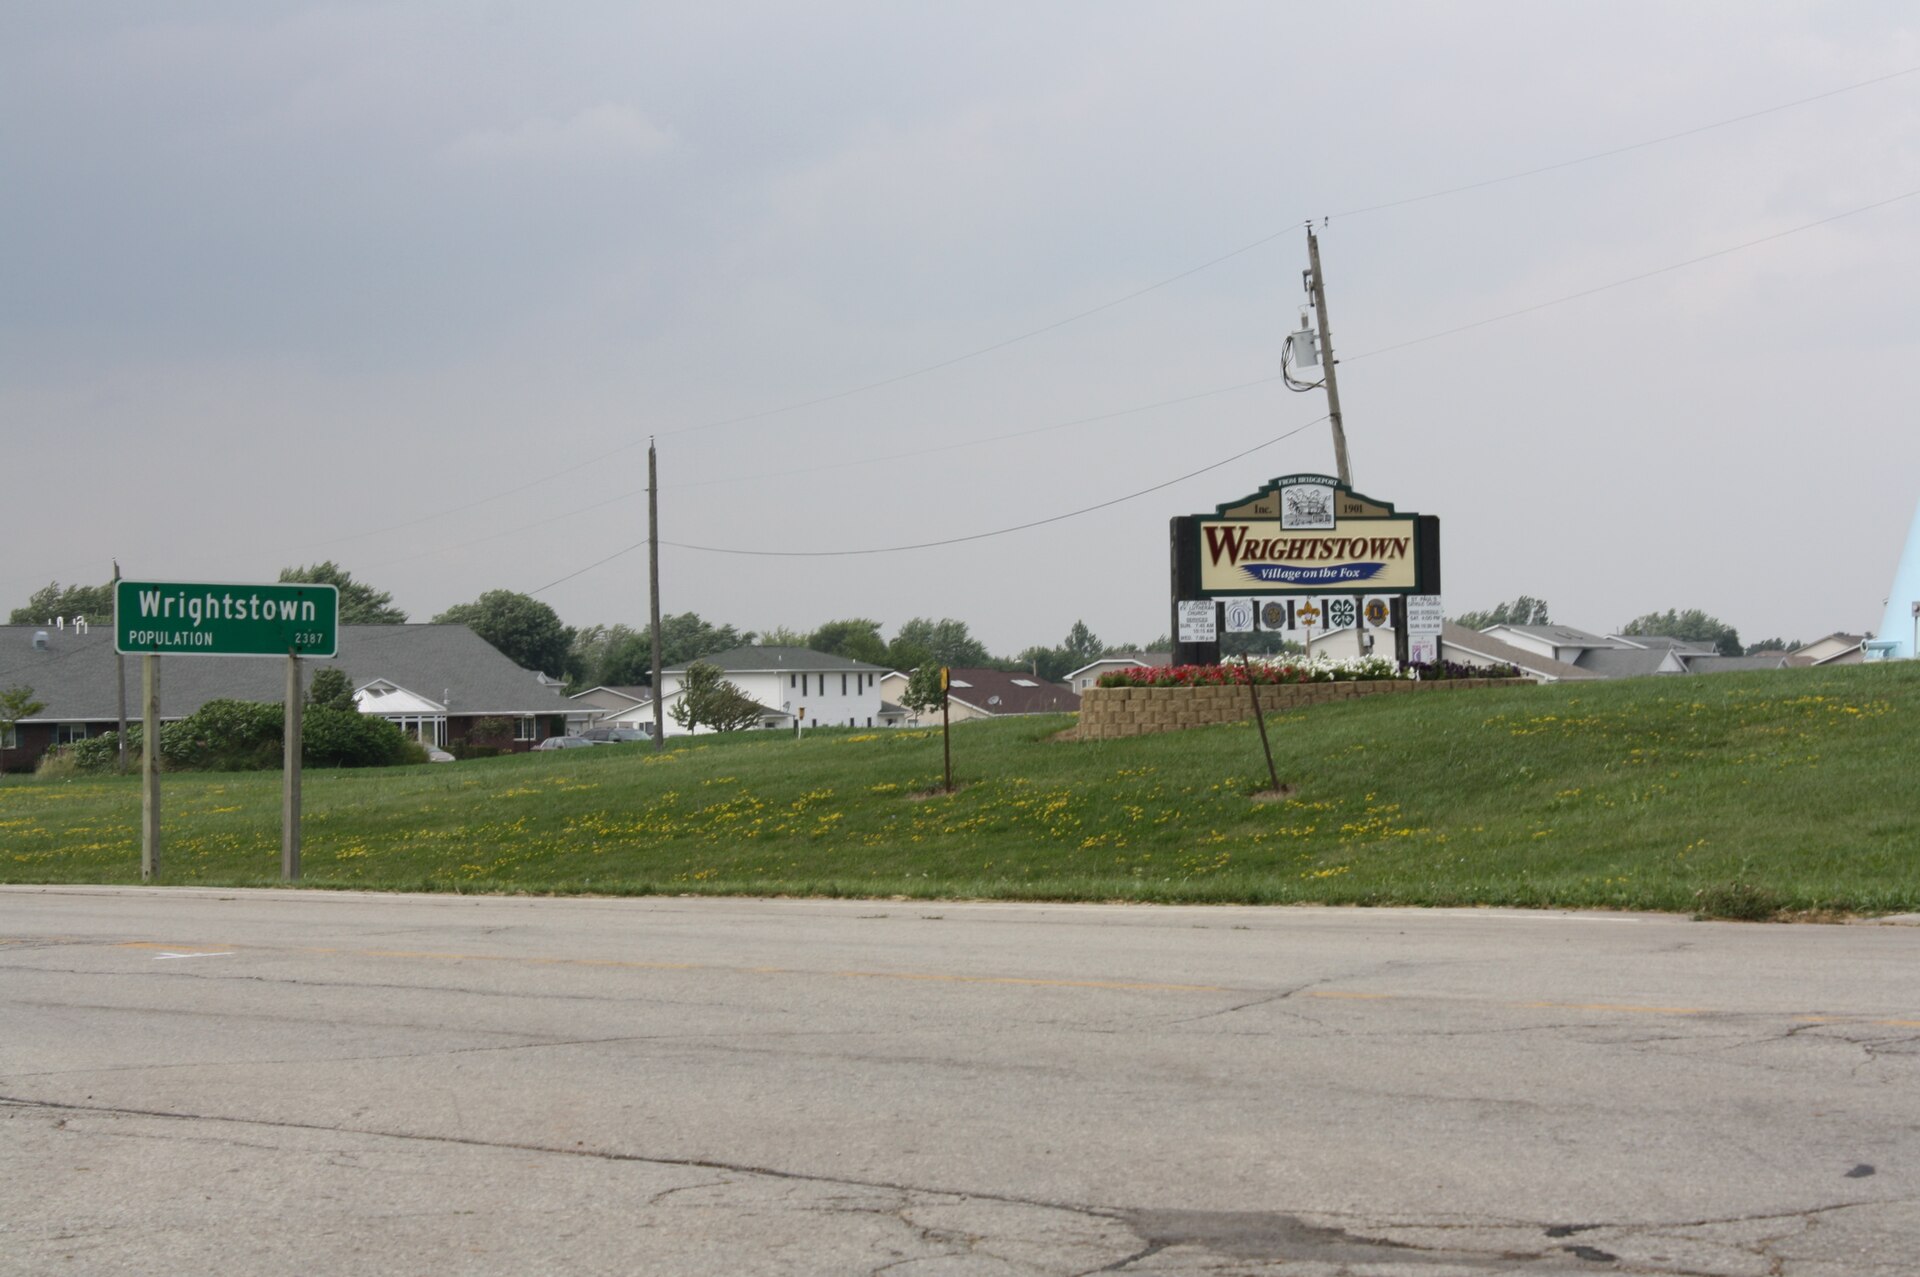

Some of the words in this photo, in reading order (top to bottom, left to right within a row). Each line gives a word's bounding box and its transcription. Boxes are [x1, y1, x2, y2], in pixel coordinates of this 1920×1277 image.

[1278, 478, 1297, 487] FROM
[1297, 476, 1338, 486] BRIDGEPORT
[1254, 504, 1272, 514] Inc.
[1343, 504, 1363, 514] 1901
[1203, 526, 1411, 567] WRIGHTSTOWN
[1261, 568, 1301, 581] Village
[1302, 570, 1318, 578] on
[1319, 568, 1338, 578] the
[1340, 567, 1360, 578] Fox
[139, 590, 316, 627] Wrightstown
[129, 630, 213, 646] POPULATION
[295, 632, 323, 644] 2387
